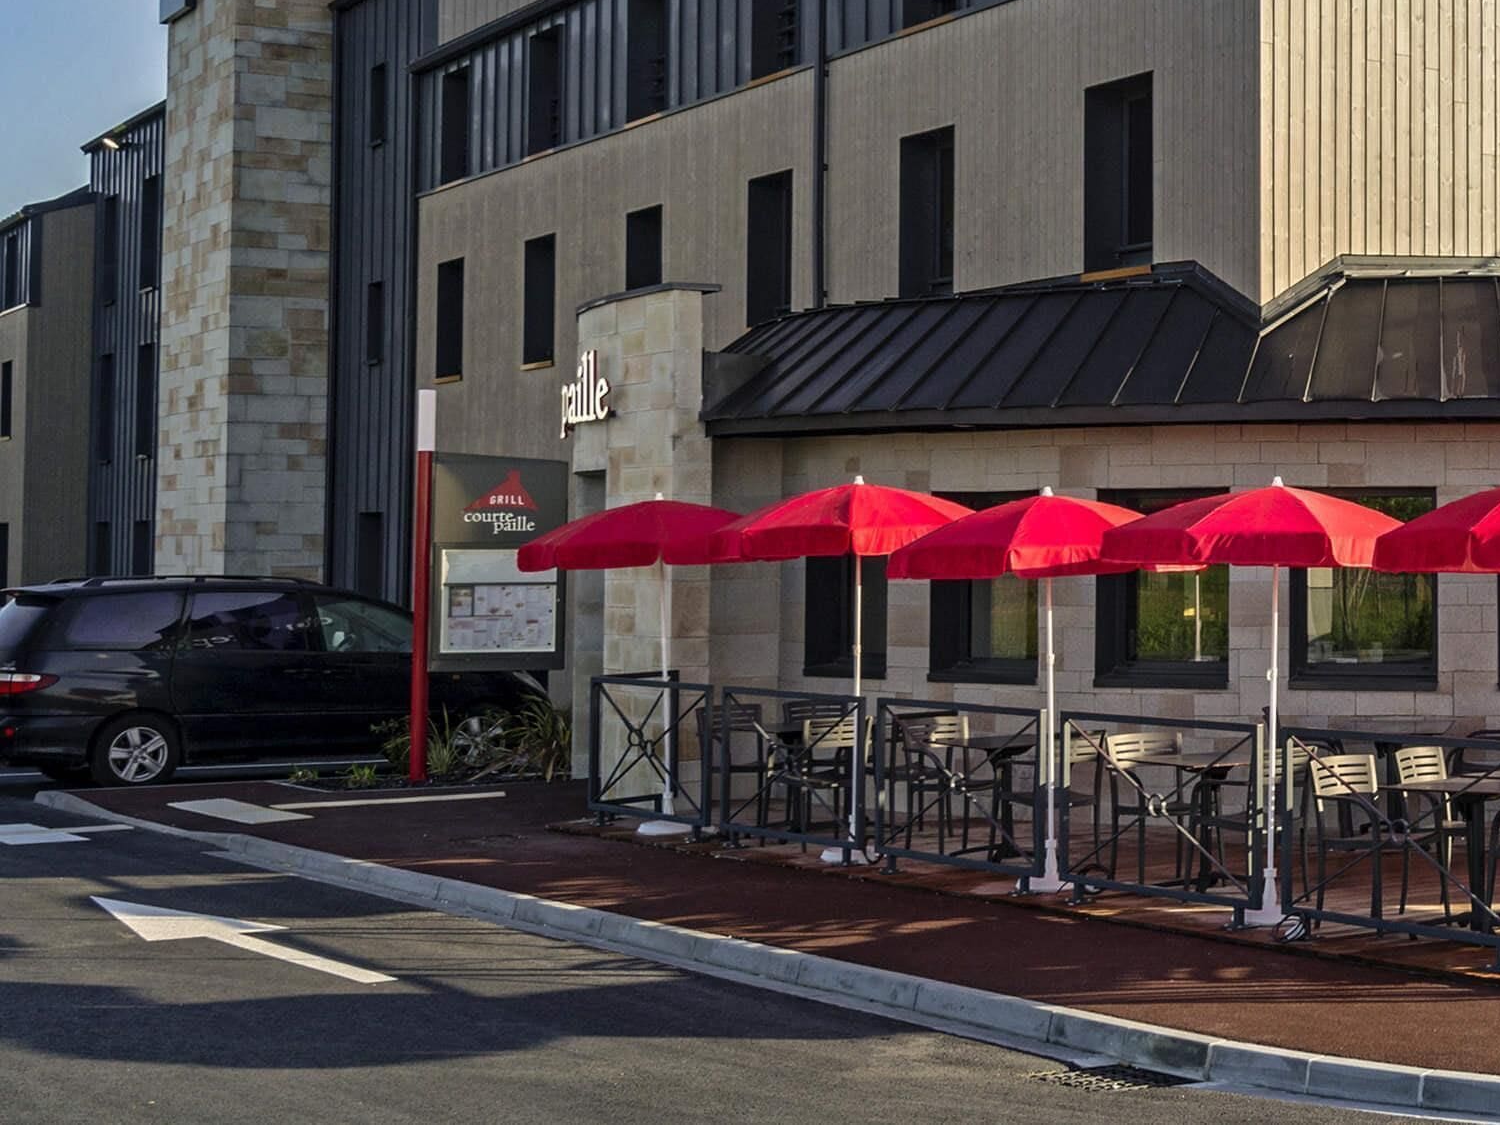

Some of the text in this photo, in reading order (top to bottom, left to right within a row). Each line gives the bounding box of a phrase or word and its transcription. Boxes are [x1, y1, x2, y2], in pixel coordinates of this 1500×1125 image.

[560, 349, 610, 440] paille
[489, 494, 525, 506] GRILL
[463, 512, 514, 523] courte
[492, 516, 536, 535] paille
